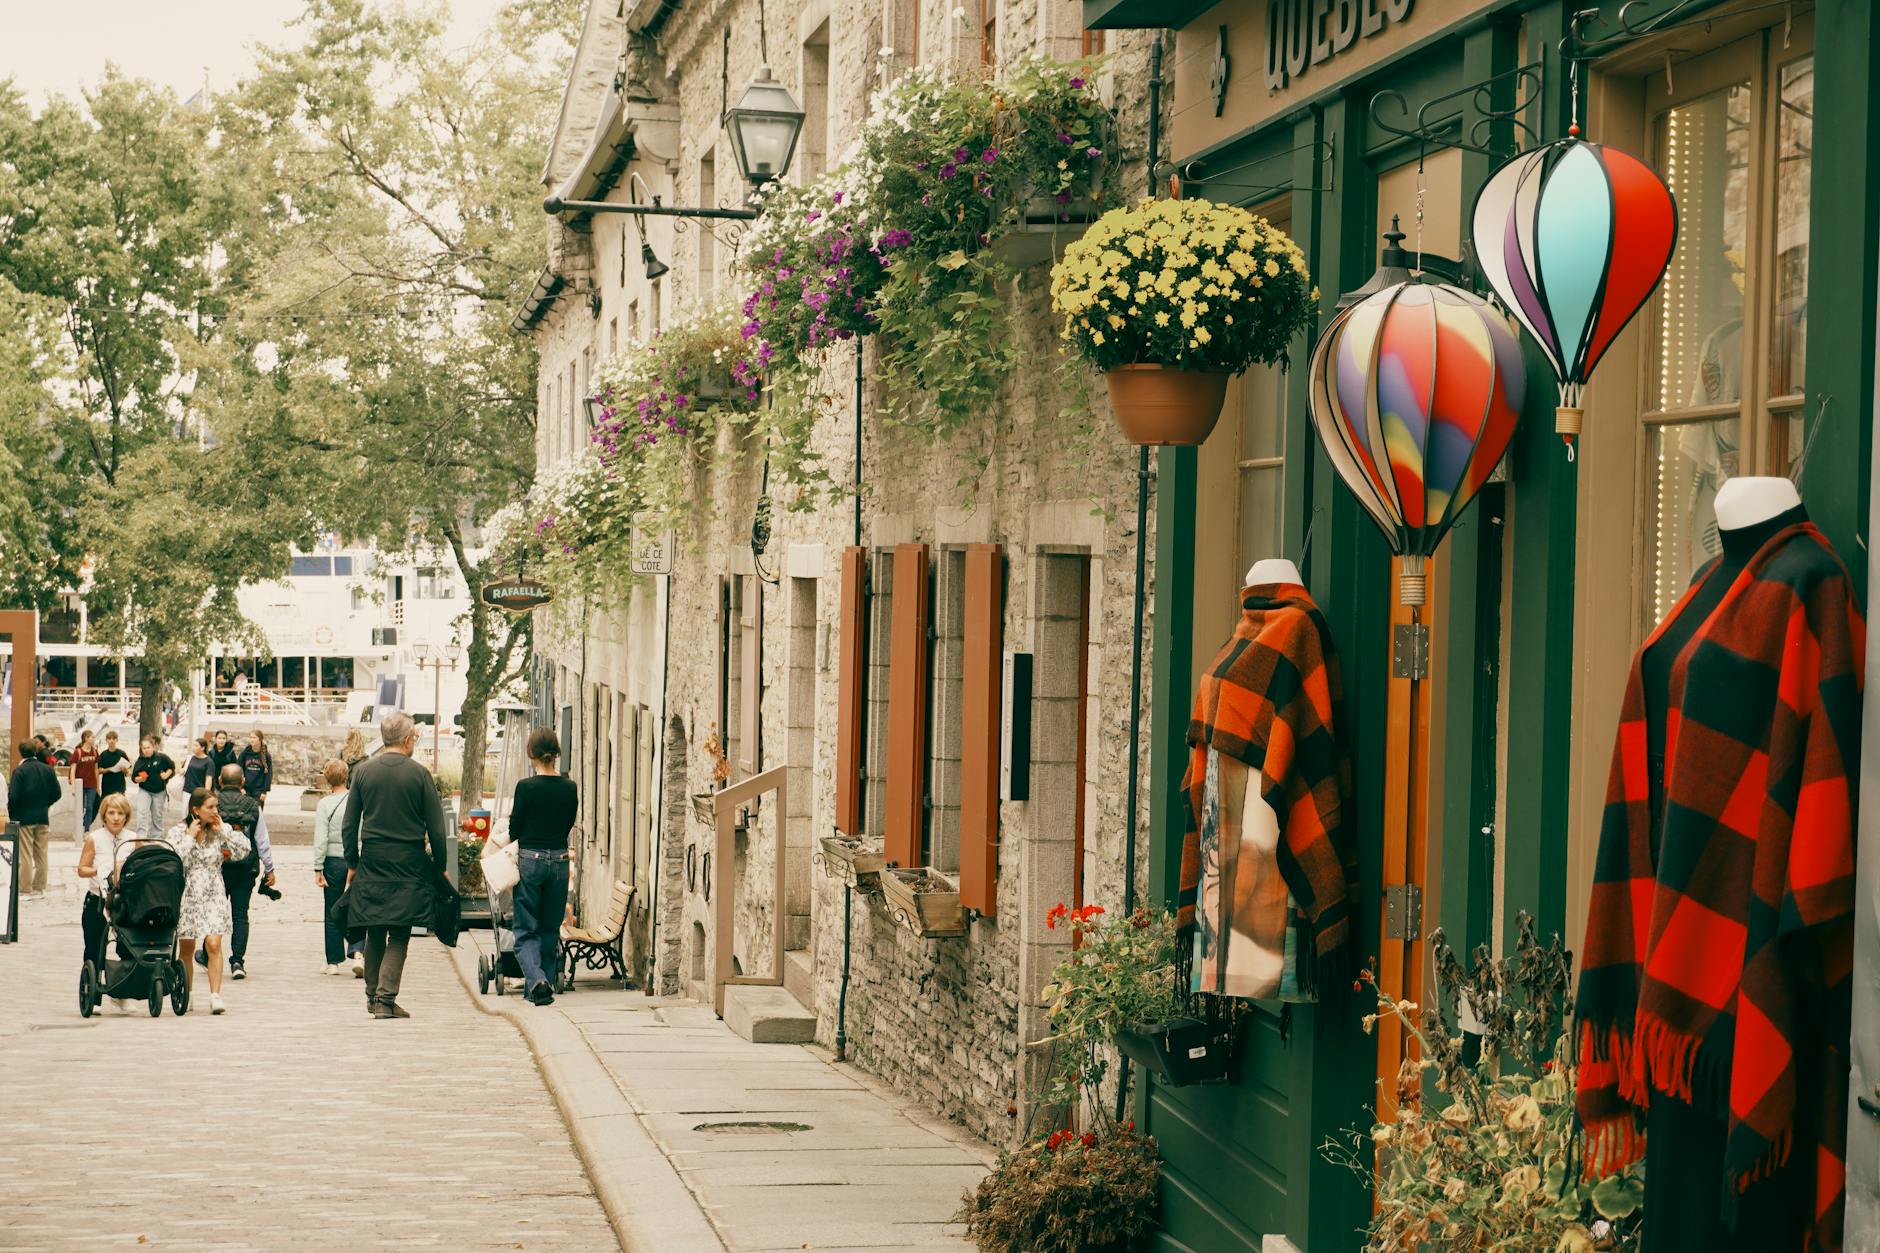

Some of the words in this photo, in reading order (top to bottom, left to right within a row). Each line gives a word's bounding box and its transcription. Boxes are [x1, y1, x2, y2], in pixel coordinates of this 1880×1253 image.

[1264, 0, 1413, 90] QUEB
[653, 549, 663, 559] CE
[492, 586, 544, 599] RAFAELLA
